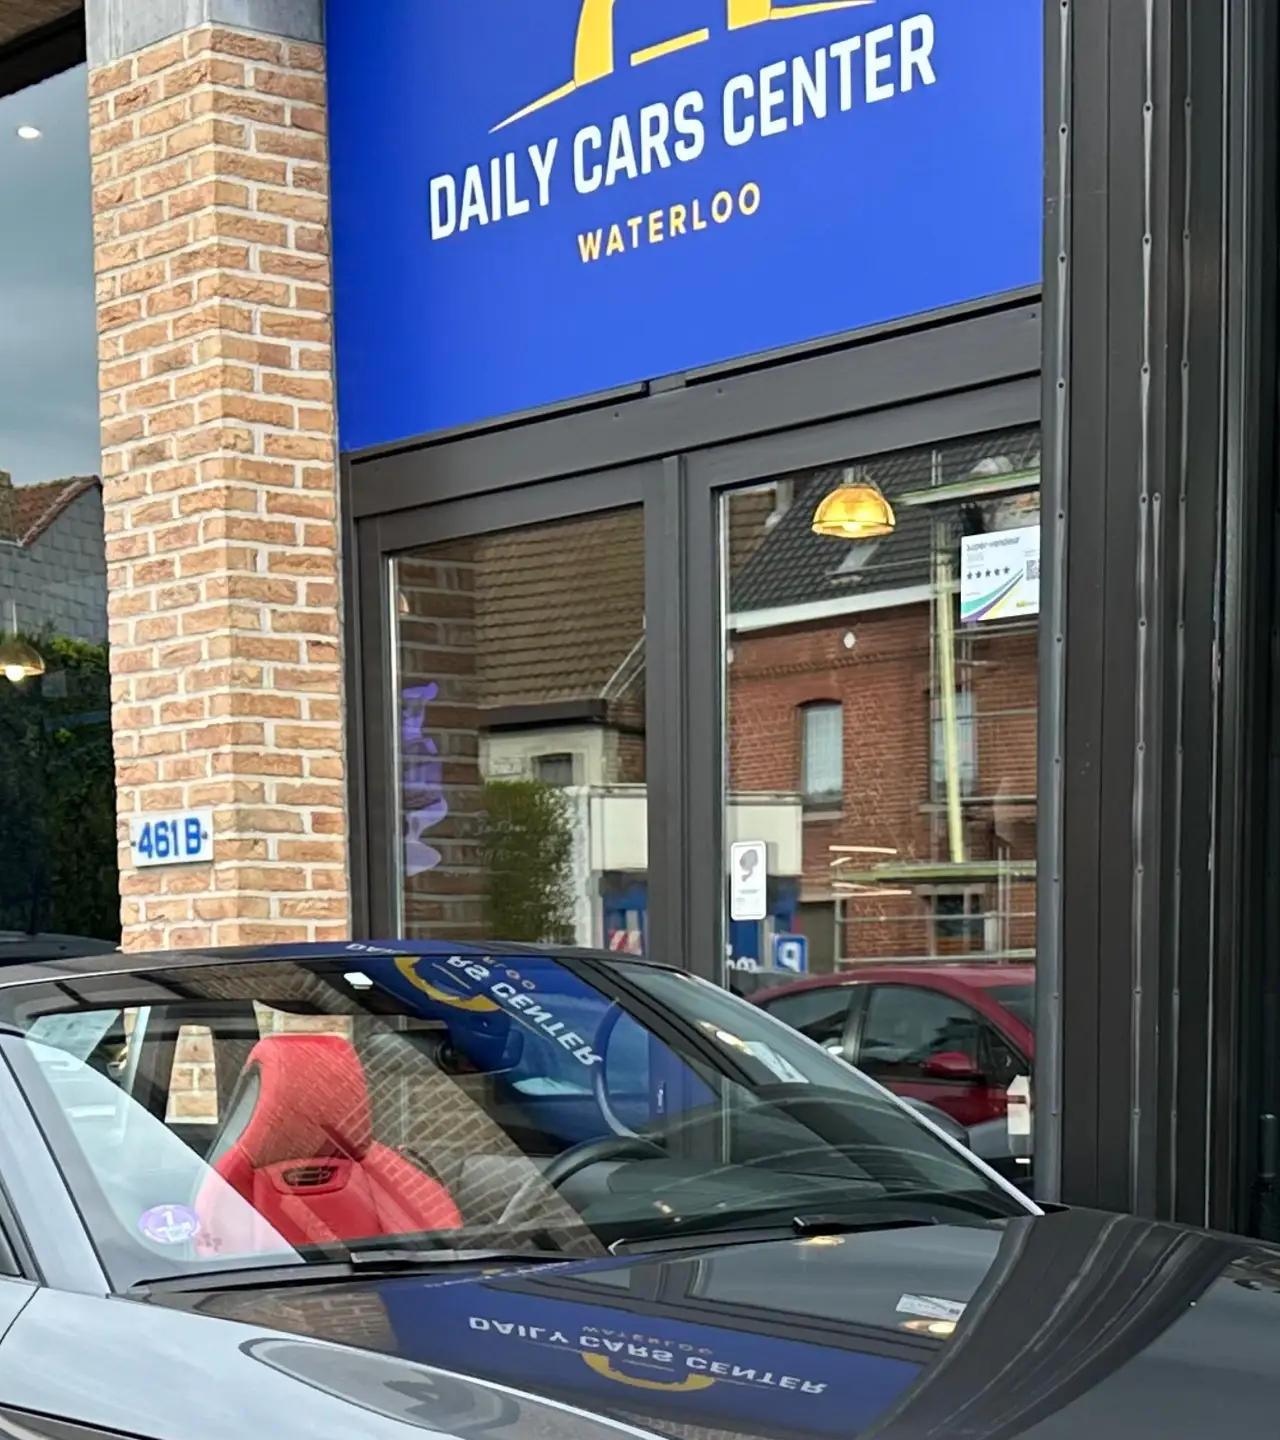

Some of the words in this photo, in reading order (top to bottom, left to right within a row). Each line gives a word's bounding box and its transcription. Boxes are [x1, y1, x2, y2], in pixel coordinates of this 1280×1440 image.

[430, 138, 558, 240] DAILY
[573, 88, 705, 195] CARS
[722, 13, 937, 147] CENTER
[577, 181, 762, 263] WATERLOO
